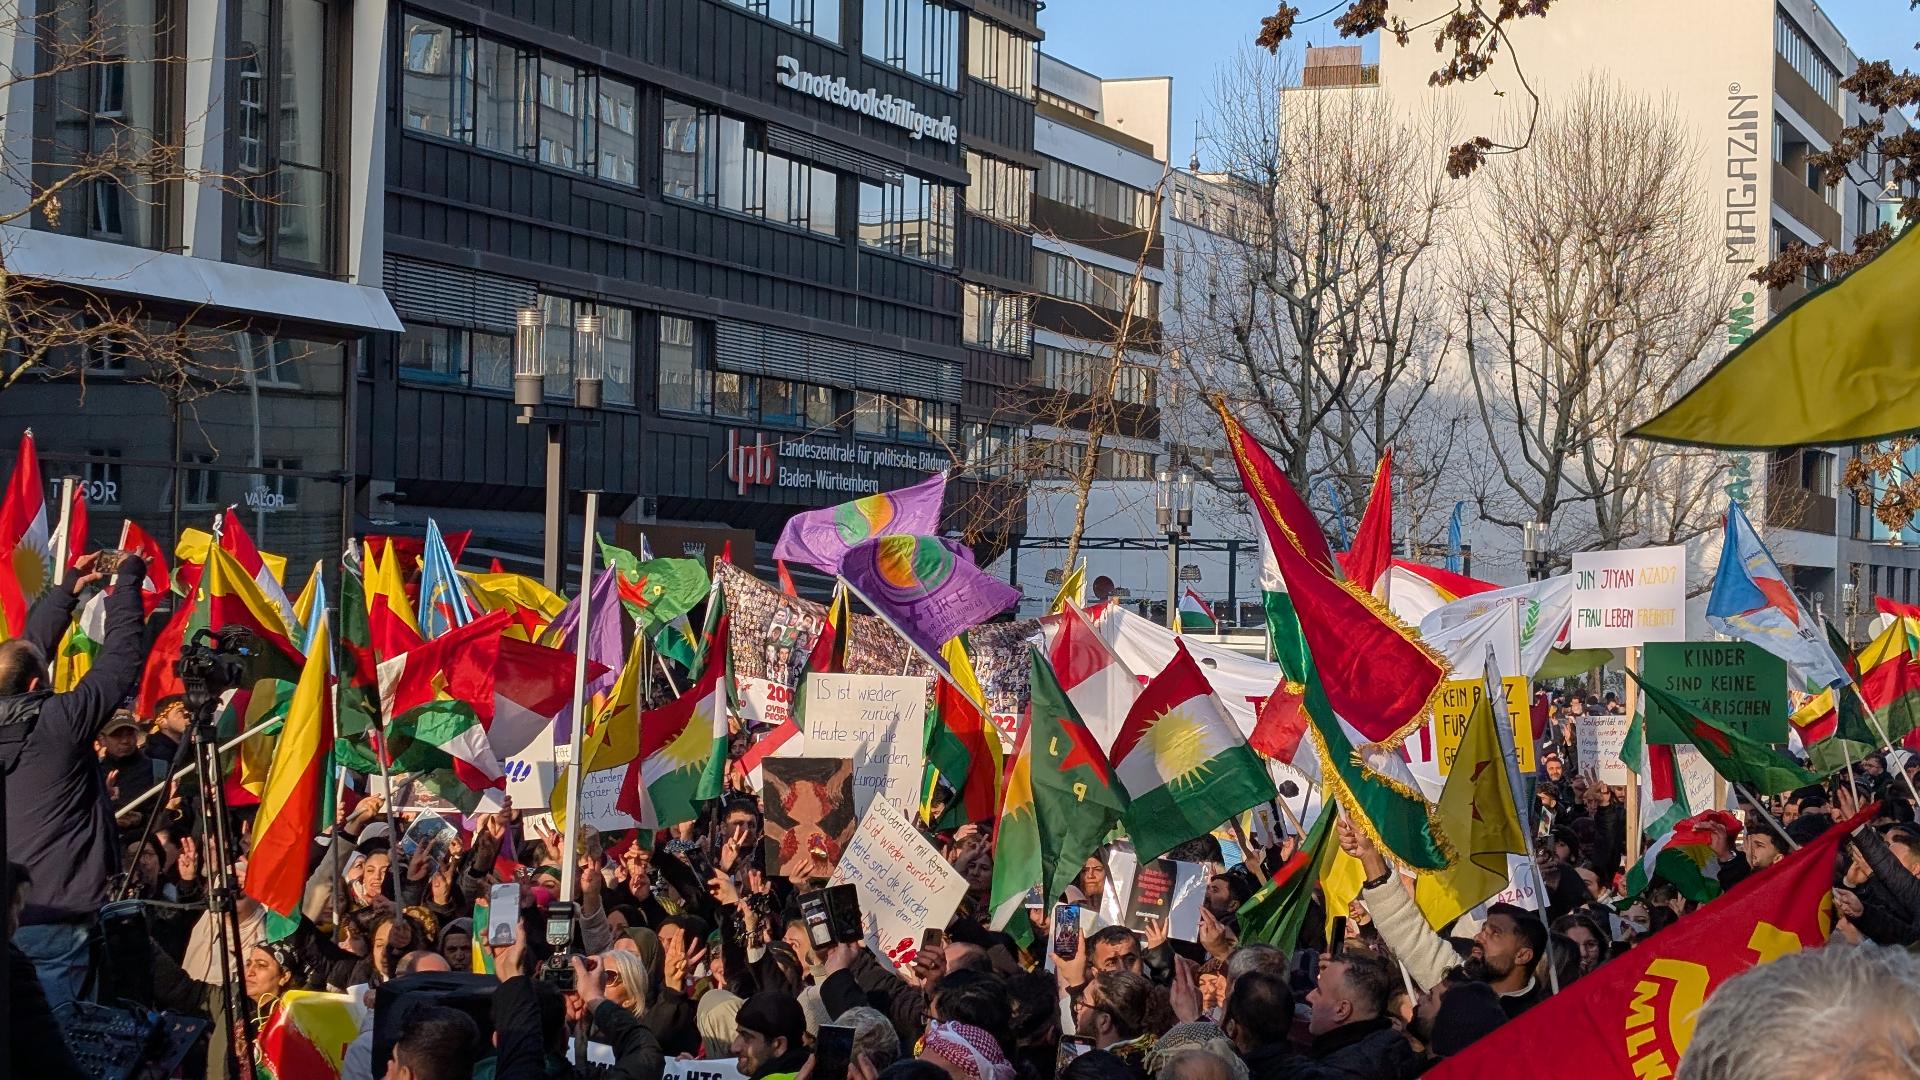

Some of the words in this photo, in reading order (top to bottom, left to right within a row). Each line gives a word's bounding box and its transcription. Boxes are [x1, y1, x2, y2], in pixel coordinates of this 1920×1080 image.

[799, 71, 957, 145] notebooksbilliger.de
[728, 429, 777, 495] lpb
[779, 435, 855, 463] Landeszentrale
[857, 444, 872, 465] für
[873, 447, 917, 471] politische
[918, 452, 951, 471] Bildung
[779, 467, 879, 494] Baden-Württemberg
[244, 491, 284, 507] VALOR
[1576, 570, 1596, 590] JIN
[1600, 569, 1634, 589] JIYAN
[1577, 608, 1602, 628] FRAU
[1604, 608, 1634, 628] LEBEN
[1684, 648, 1745, 667] KINDER
[816, 679, 831, 700] IS
[837, 680, 851, 700] ist
[858, 682, 902, 702] wieder
[1665, 675, 1702, 691] SIND
[1711, 675, 1756, 692] KEINE
[765, 704, 785, 714] OVER
[1443, 687, 1468, 708] KEIN
[860, 703, 900, 721] zurück
[812, 721, 848, 741] Heute
[853, 724, 875, 743] sind
[880, 725, 897, 744] die
[1443, 714, 1467, 737] FÜR
[863, 745, 911, 767] Kurden,
[854, 766, 899, 792] Europäer
[862, 815, 875, 831] IS
[879, 836, 906, 863] wieder
[873, 802, 916, 847] Solidarität
[914, 844, 928, 860] mit
[850, 835, 872, 864] Heute
[868, 861, 893, 880] sind
[886, 872, 902, 892] die
[840, 856, 864, 881] morgen
[864, 878, 896, 908] Europäer
